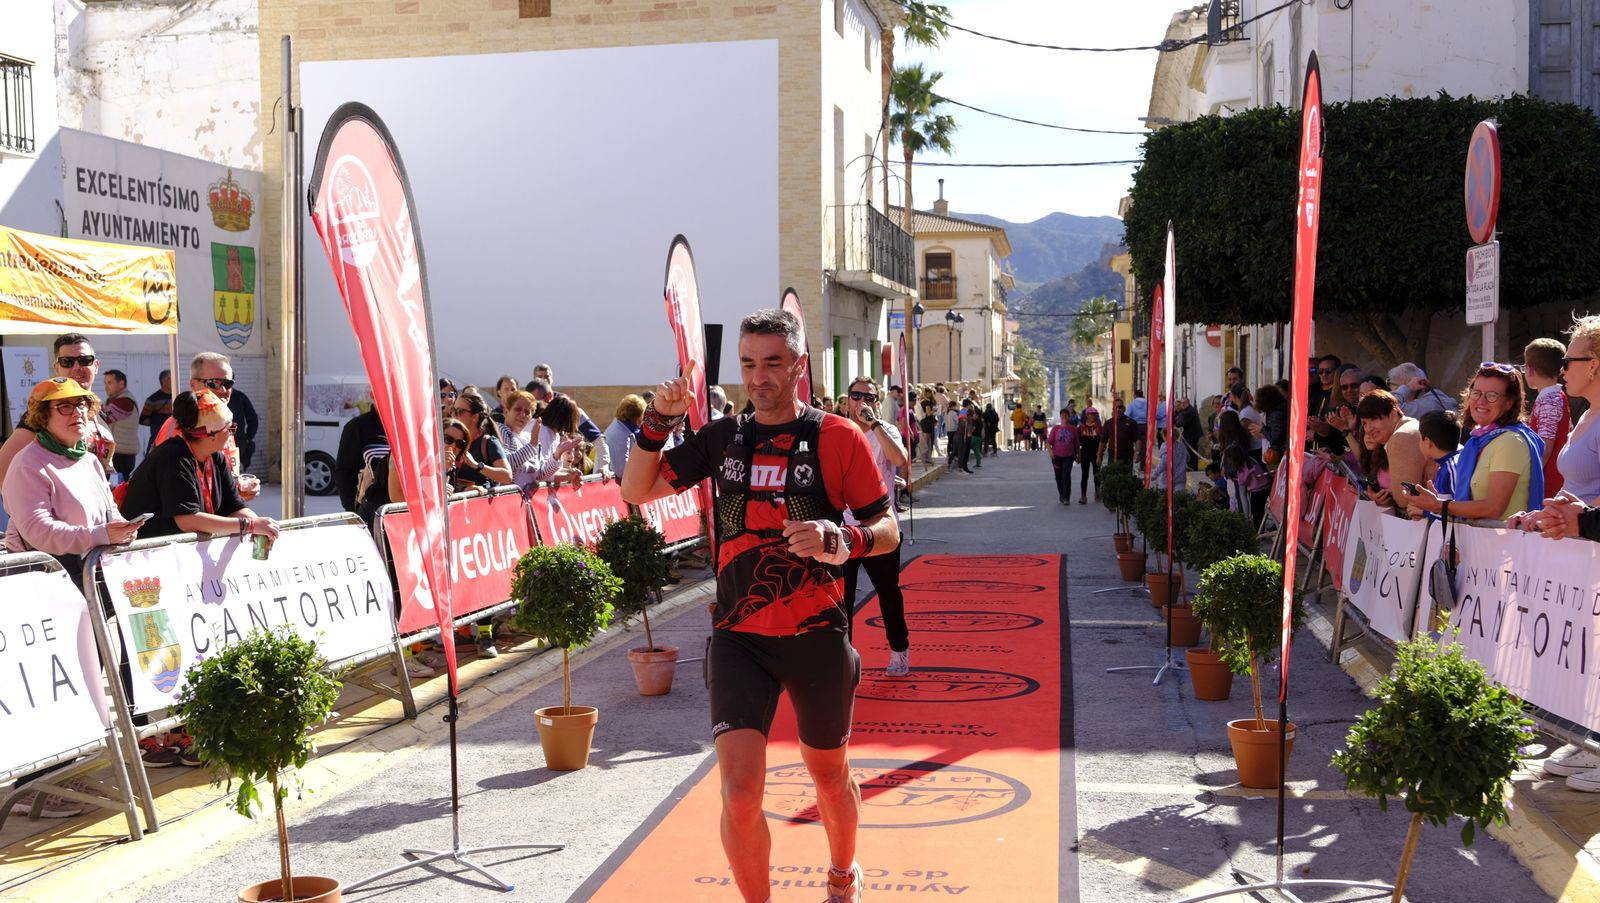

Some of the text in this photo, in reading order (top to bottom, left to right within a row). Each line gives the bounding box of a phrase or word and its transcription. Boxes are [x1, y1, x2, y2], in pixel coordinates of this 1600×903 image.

[76, 167, 200, 213] EXCELENTÍSIMO
[82, 210, 200, 249] AYUNTAMIENTO
[724, 467, 746, 483] MAX
[657, 489, 698, 522] VEOLIA
[185, 555, 369, 603] AYUNTAMIENTO DE
[449, 528, 521, 584] VEOLIA
[21, 618, 57, 646] DE
[190, 580, 382, 654] CANTORIA
[1456, 594, 1600, 680] CANTORI
